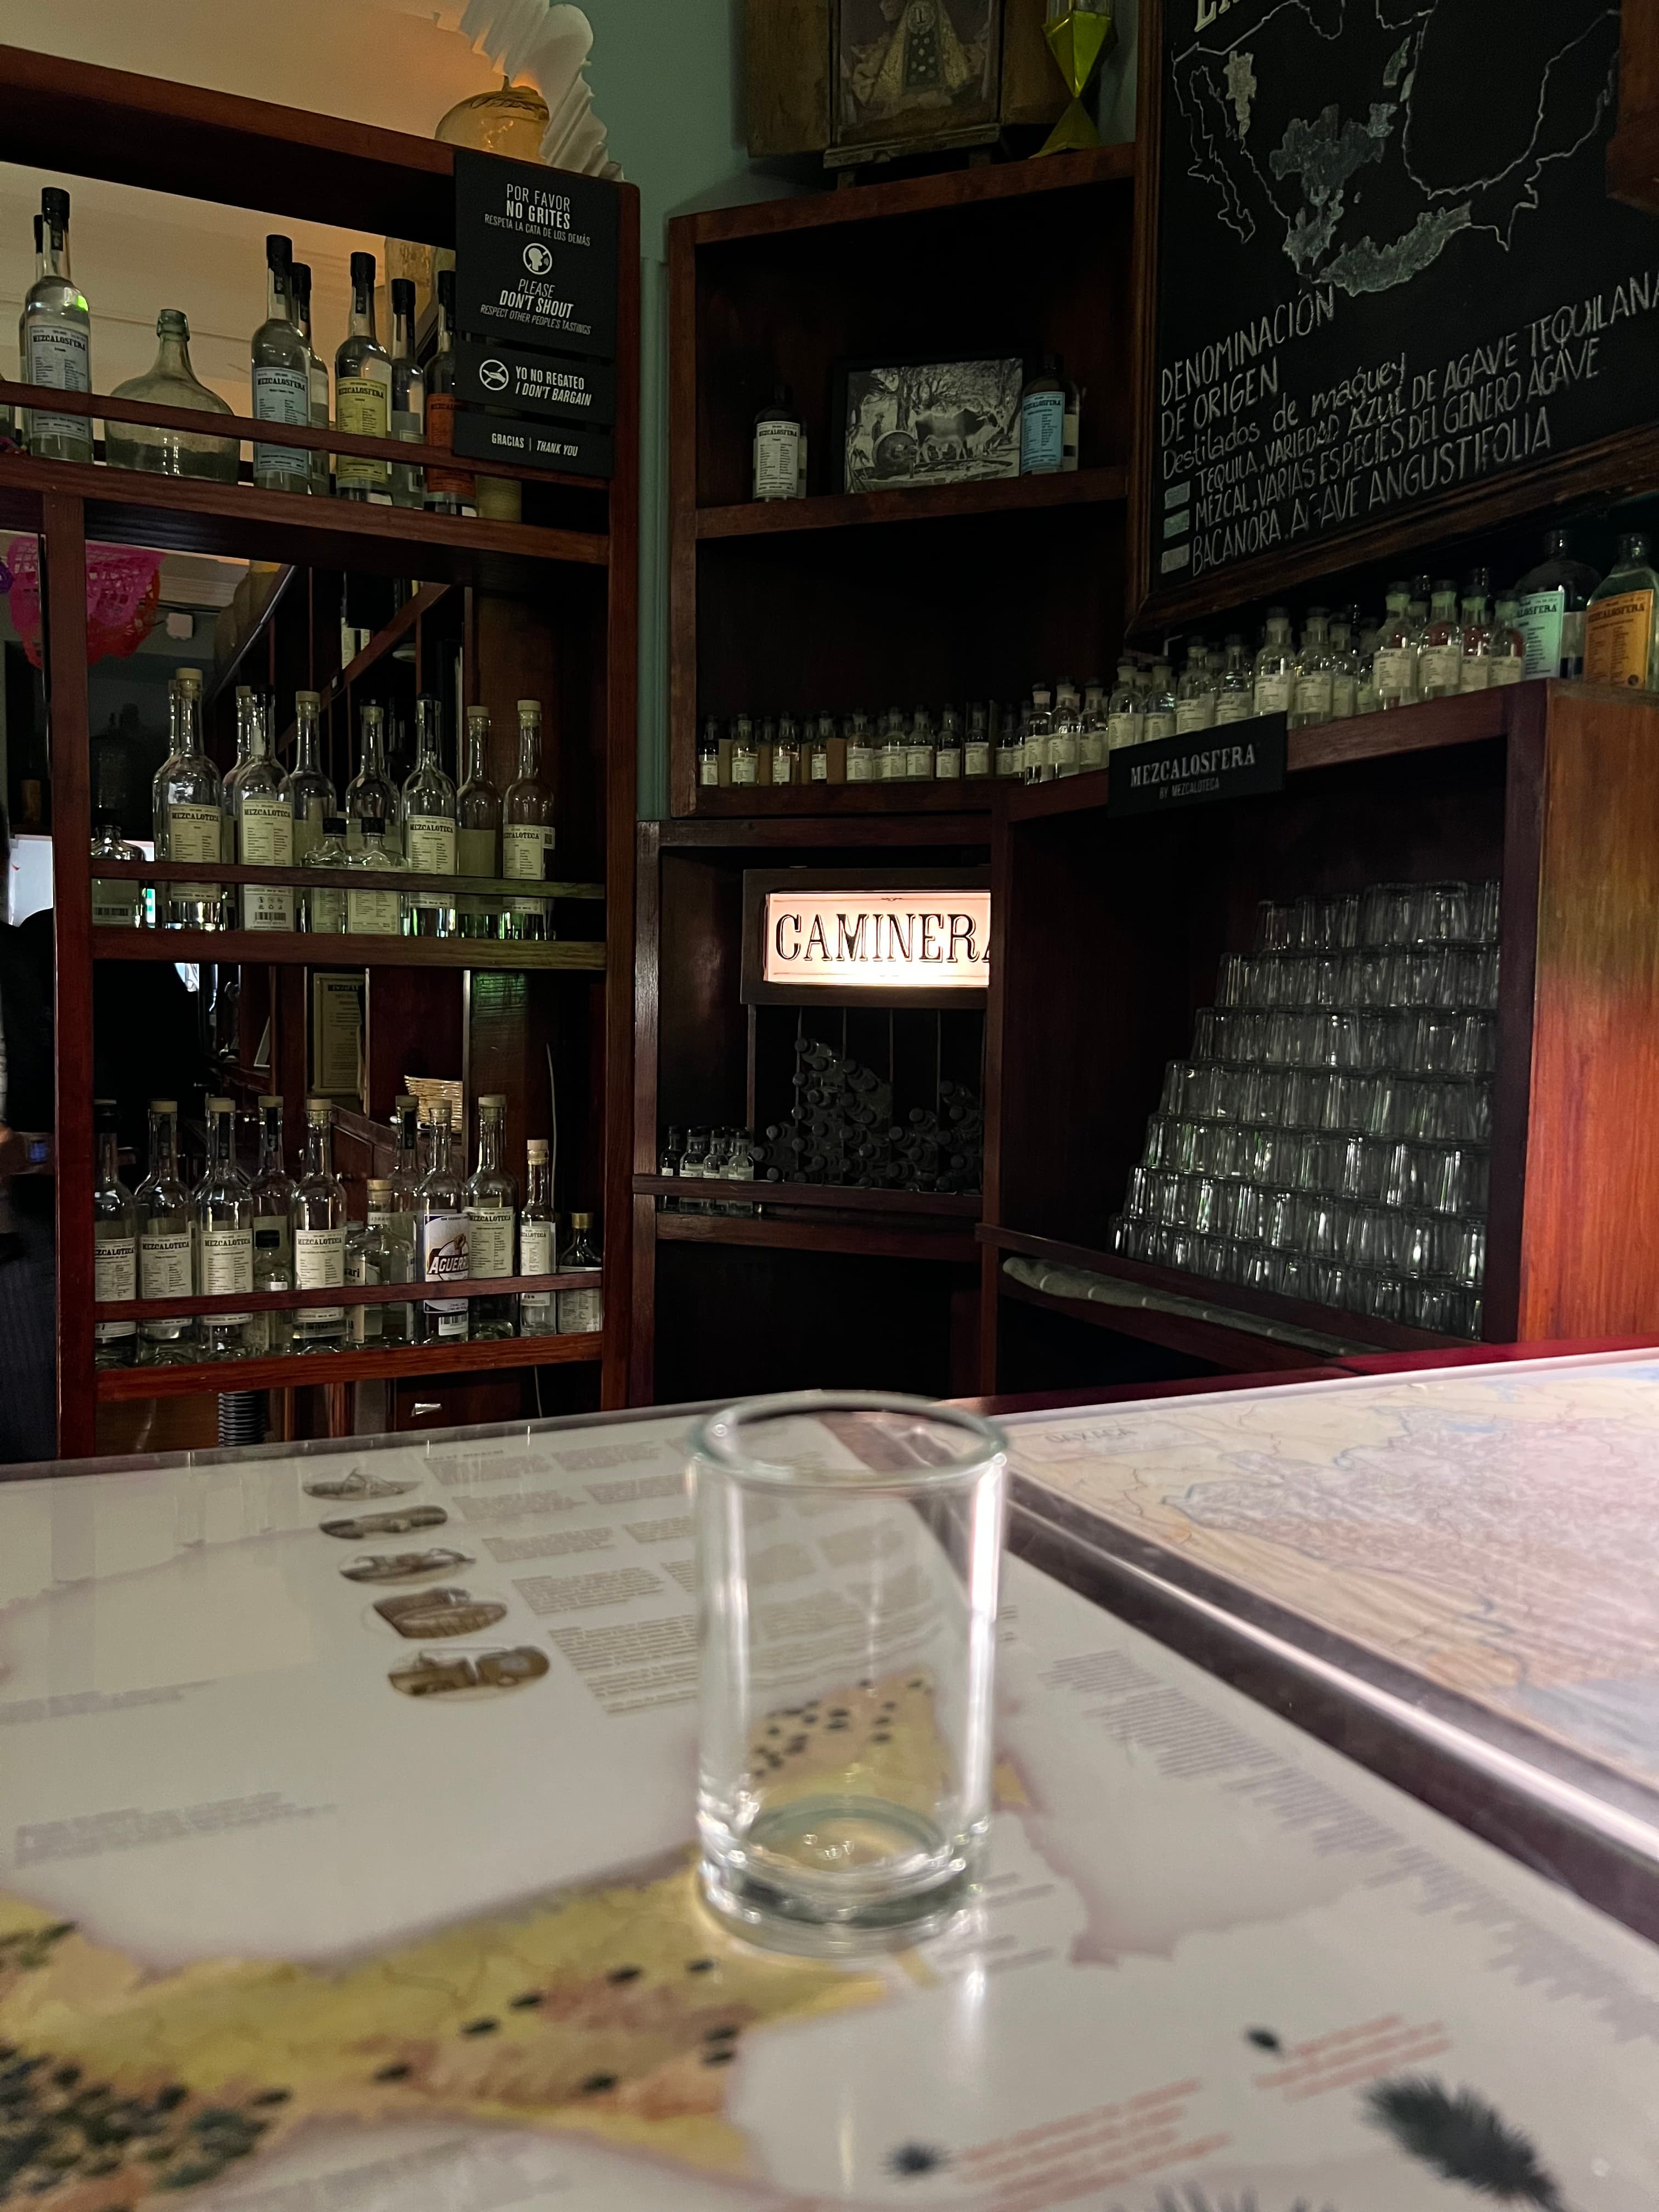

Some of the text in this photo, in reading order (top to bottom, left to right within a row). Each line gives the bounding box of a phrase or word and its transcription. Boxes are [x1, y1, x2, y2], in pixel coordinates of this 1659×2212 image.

[507, 184, 570, 212] POR FAVOR
[506, 200, 570, 229] NO GRITES
[484, 213, 590, 246] RESPETA LA CATA DE LOS DEMÁS
[518, 279, 556, 298] PLEASE
[499, 290, 574, 318] DON'T SHOUT
[481, 304, 509, 318] RESPECT
[509, 310, 531, 323] OTHER
[562, 320, 591, 335] TASTINGS
[33, 335, 86, 351] MEZCALOSFERA
[1161, 282, 1334, 407] DENOMINACIÓN
[257, 377, 306, 391] MEZCALOSFERA
[516, 366, 584, 390] YO NO REGATEO
[1348, 386, 1407, 436] AZUL
[1412, 369, 1437, 410] DE
[1443, 332, 1519, 398] AGAVE
[338, 387, 384, 399] MEZCALOSFERA
[515, 381, 592, 406] I DON'T BARGAIN
[1161, 356, 1279, 447] DE ORIGEN
[1164, 352, 1406, 480] Destilados de maguey
[1258, 458, 1316, 507] VARIAS
[1319, 418, 1404, 484] ESPECIES
[1409, 405, 1440, 450] DEL
[1444, 371, 1521, 433] GENERO
[1526, 338, 1600, 403] AGAVE
[492, 433, 578, 456] GRACIAS THANK YOU
[1369, 405, 1551, 511] ANGUSTIFOLIA
[1130, 743, 1256, 788] MEZCALOSFERA
[1159, 777, 1220, 799] BY MEZCALOTECA
[172, 812, 219, 822] MEZCALOTECA
[244, 809, 291, 818] MEZCALOTECA
[410, 824, 453, 833] MEZCALOTECA
[142, 1242, 190, 1250] MEZCALOTECA
[205, 1238, 251, 1246] MEZCALOTECA
[298, 1237, 342, 1245] MEZCALOTECA
